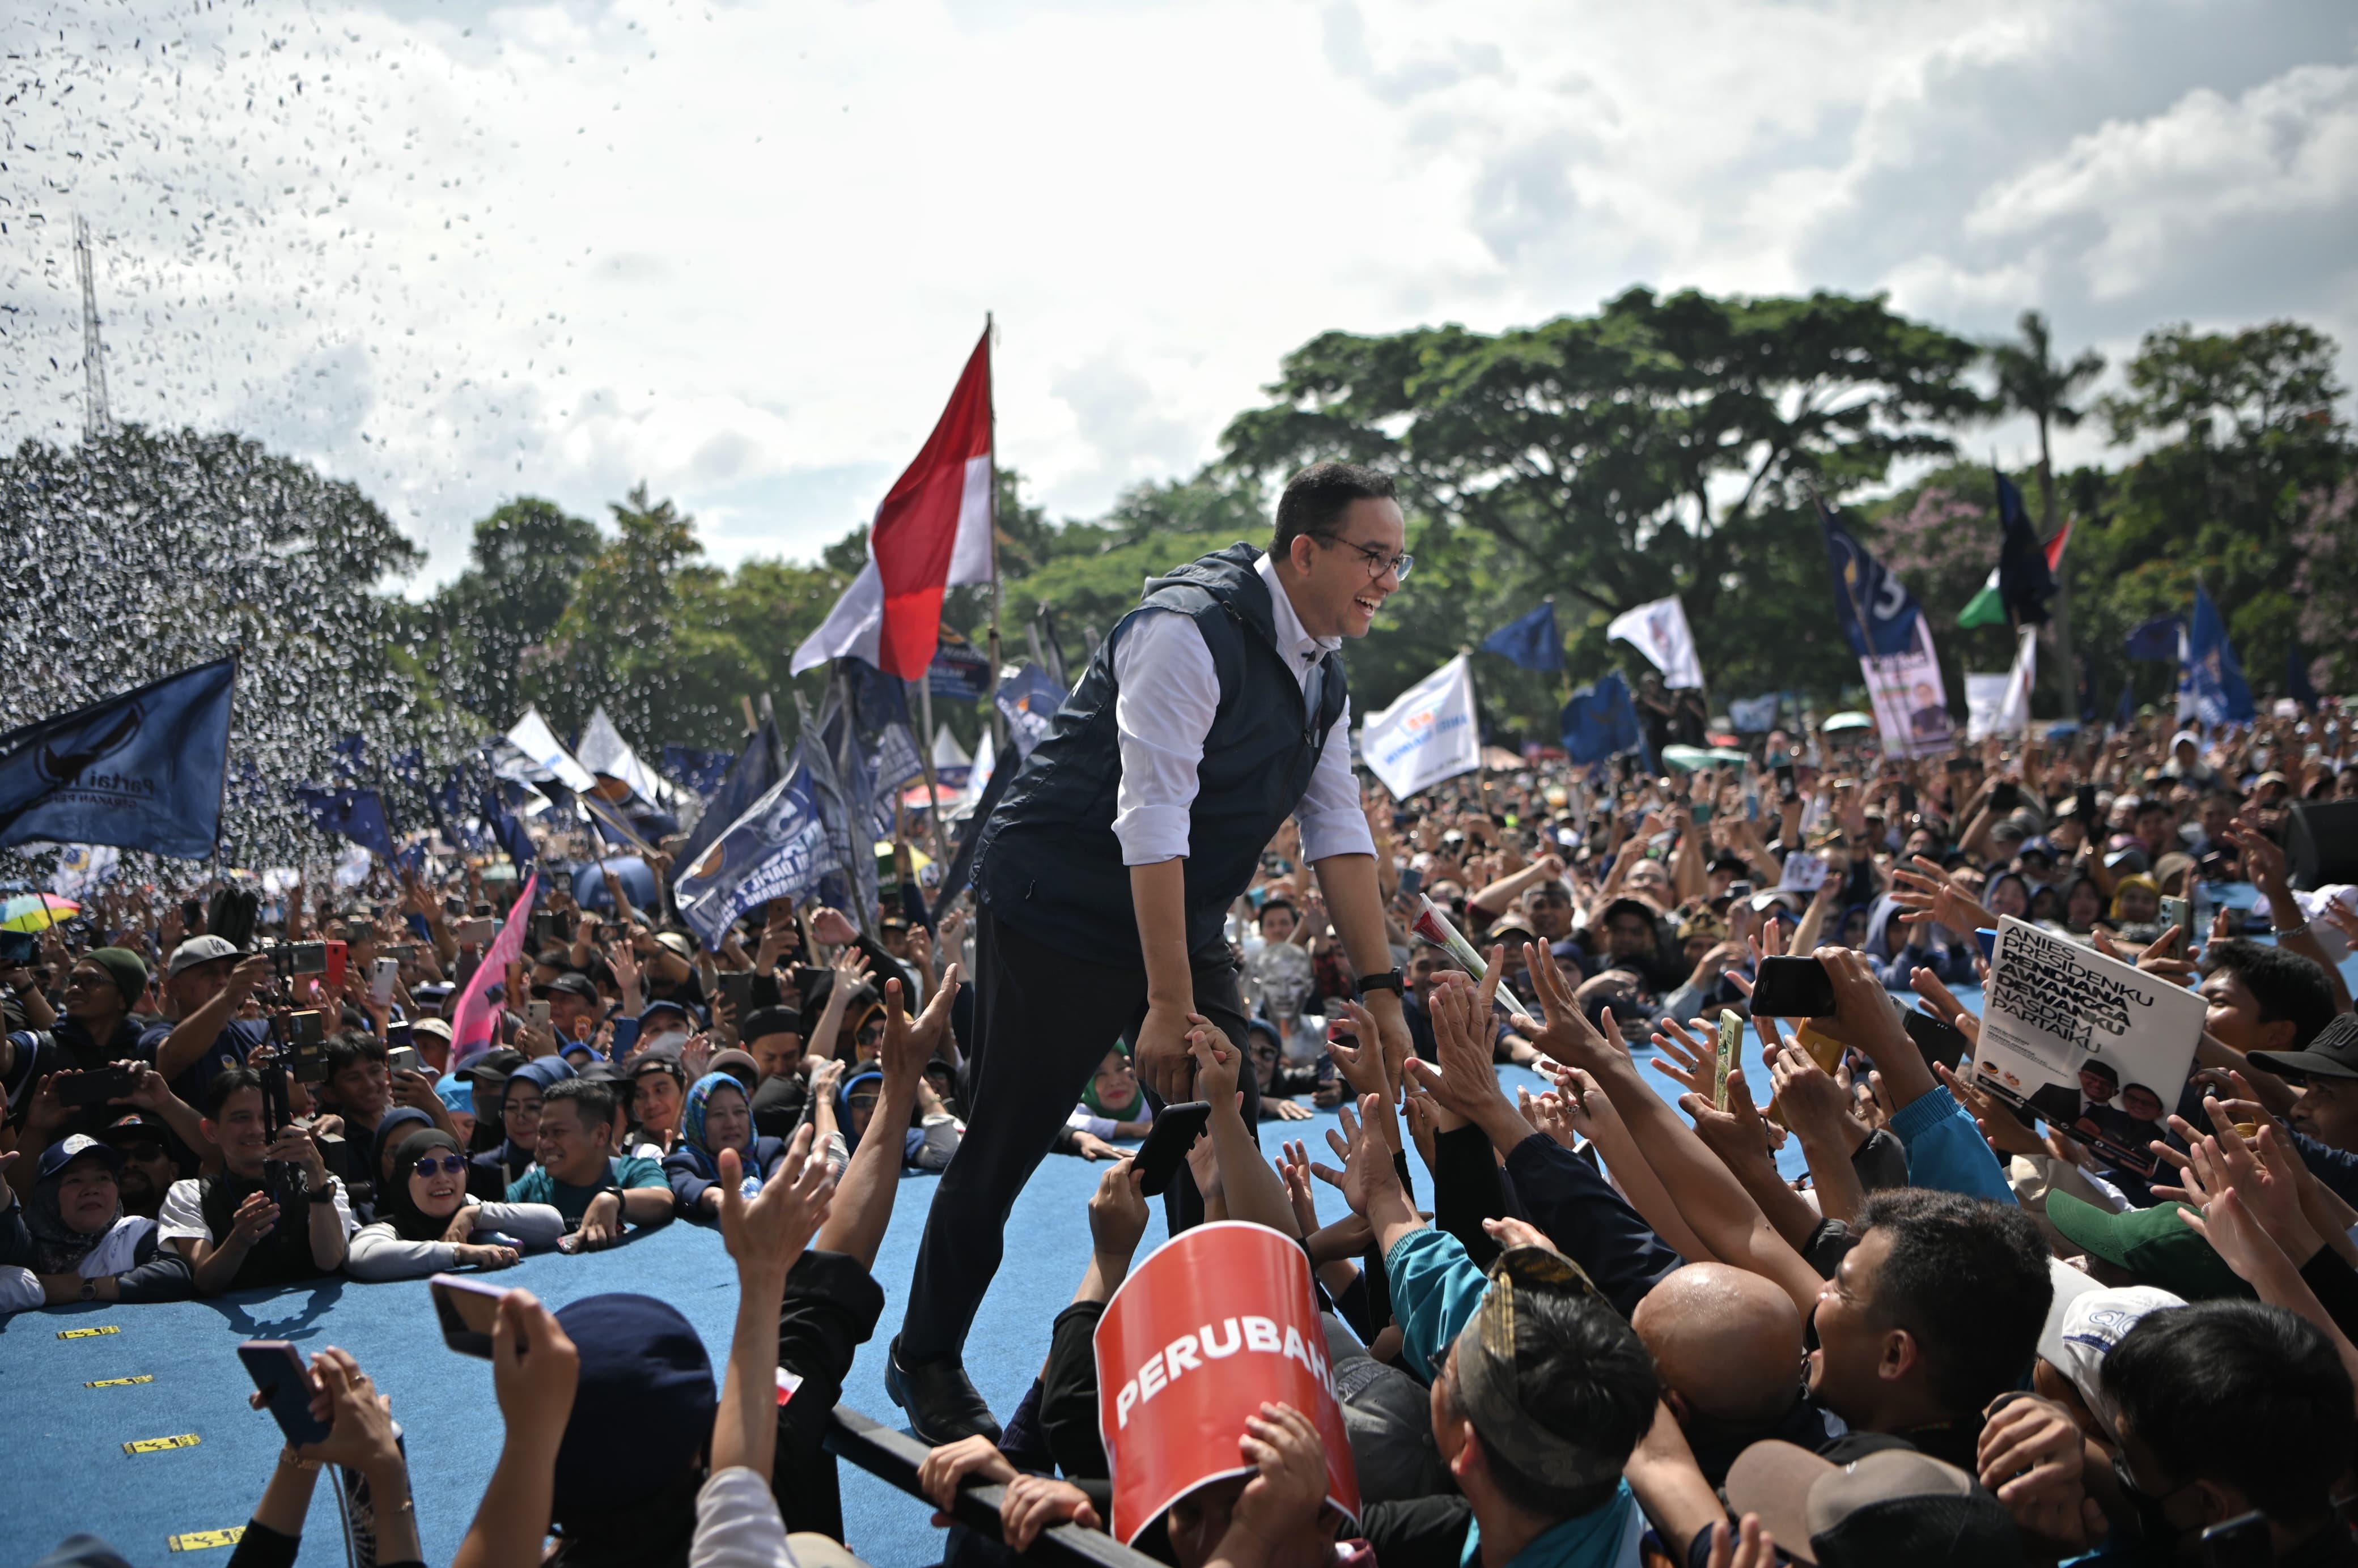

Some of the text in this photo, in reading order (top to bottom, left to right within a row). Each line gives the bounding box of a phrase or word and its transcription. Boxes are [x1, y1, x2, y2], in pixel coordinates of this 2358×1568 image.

[2003, 936, 2154, 1007] PRESIDENKU
[2005, 926, 2076, 961] ANIES
[1994, 985, 2093, 1037] NASDEM
[1996, 973, 2125, 1036] DEWANKU
[1999, 963, 2131, 1027] AWANGGA
[2001, 949, 2128, 1013] RENDIANA
[1992, 997, 2101, 1053] PARTAIKU
